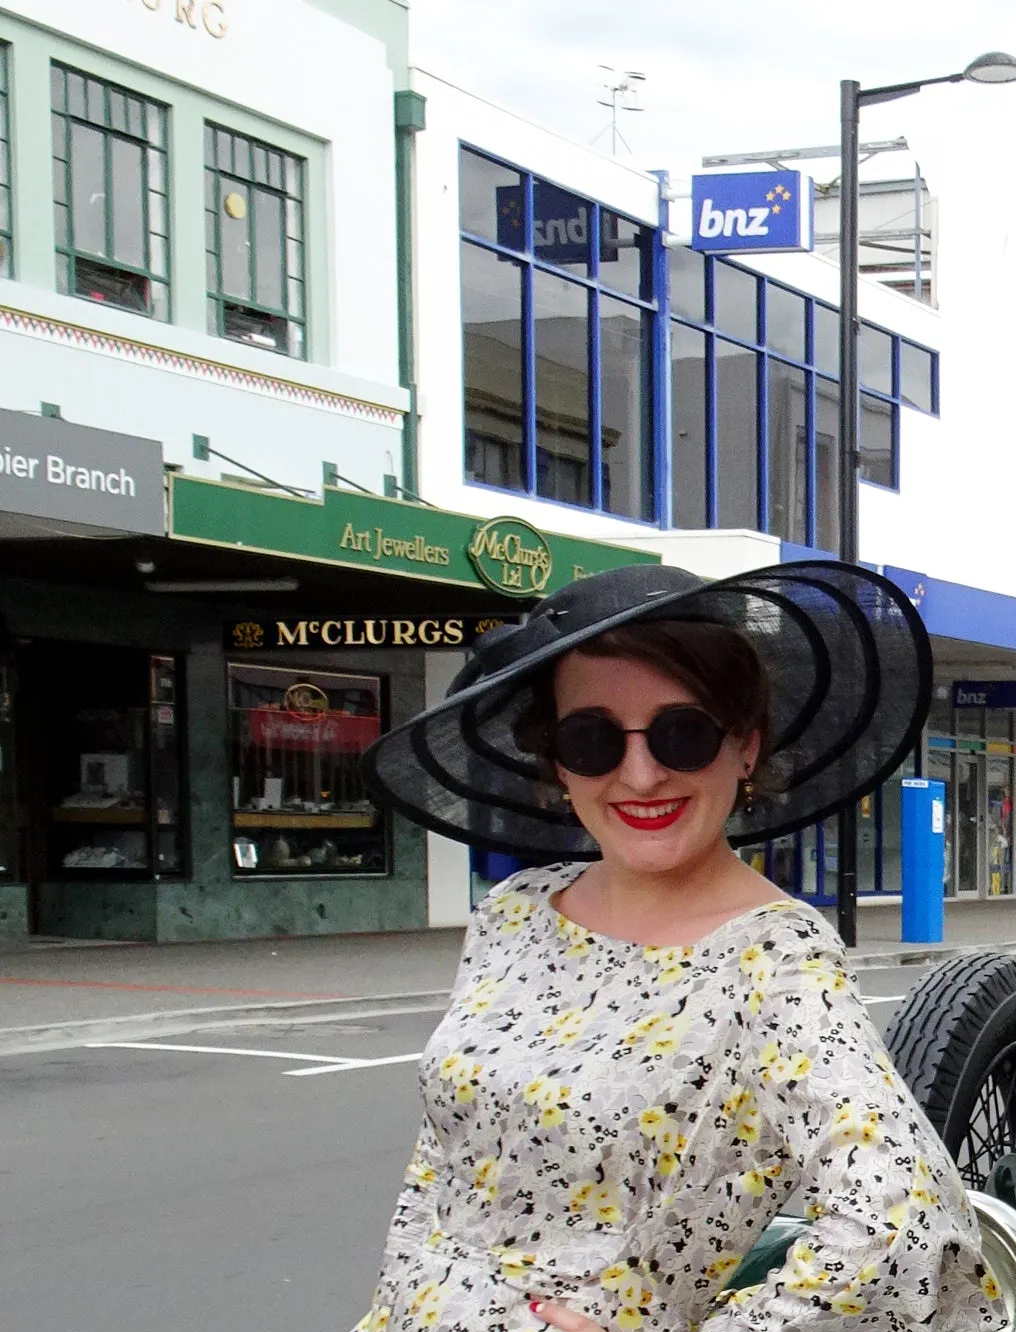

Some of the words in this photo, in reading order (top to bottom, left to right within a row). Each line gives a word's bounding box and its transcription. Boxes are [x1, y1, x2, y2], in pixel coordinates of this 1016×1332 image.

[698, 199, 771, 239] bnz
[0, 446, 39, 479] ier
[46, 454, 136, 497] Branch
[339, 523, 372, 553] Art
[373, 527, 449, 566] Jewellers
[501, 562, 523, 588] Ltd
[956, 687, 987, 705] bnz
